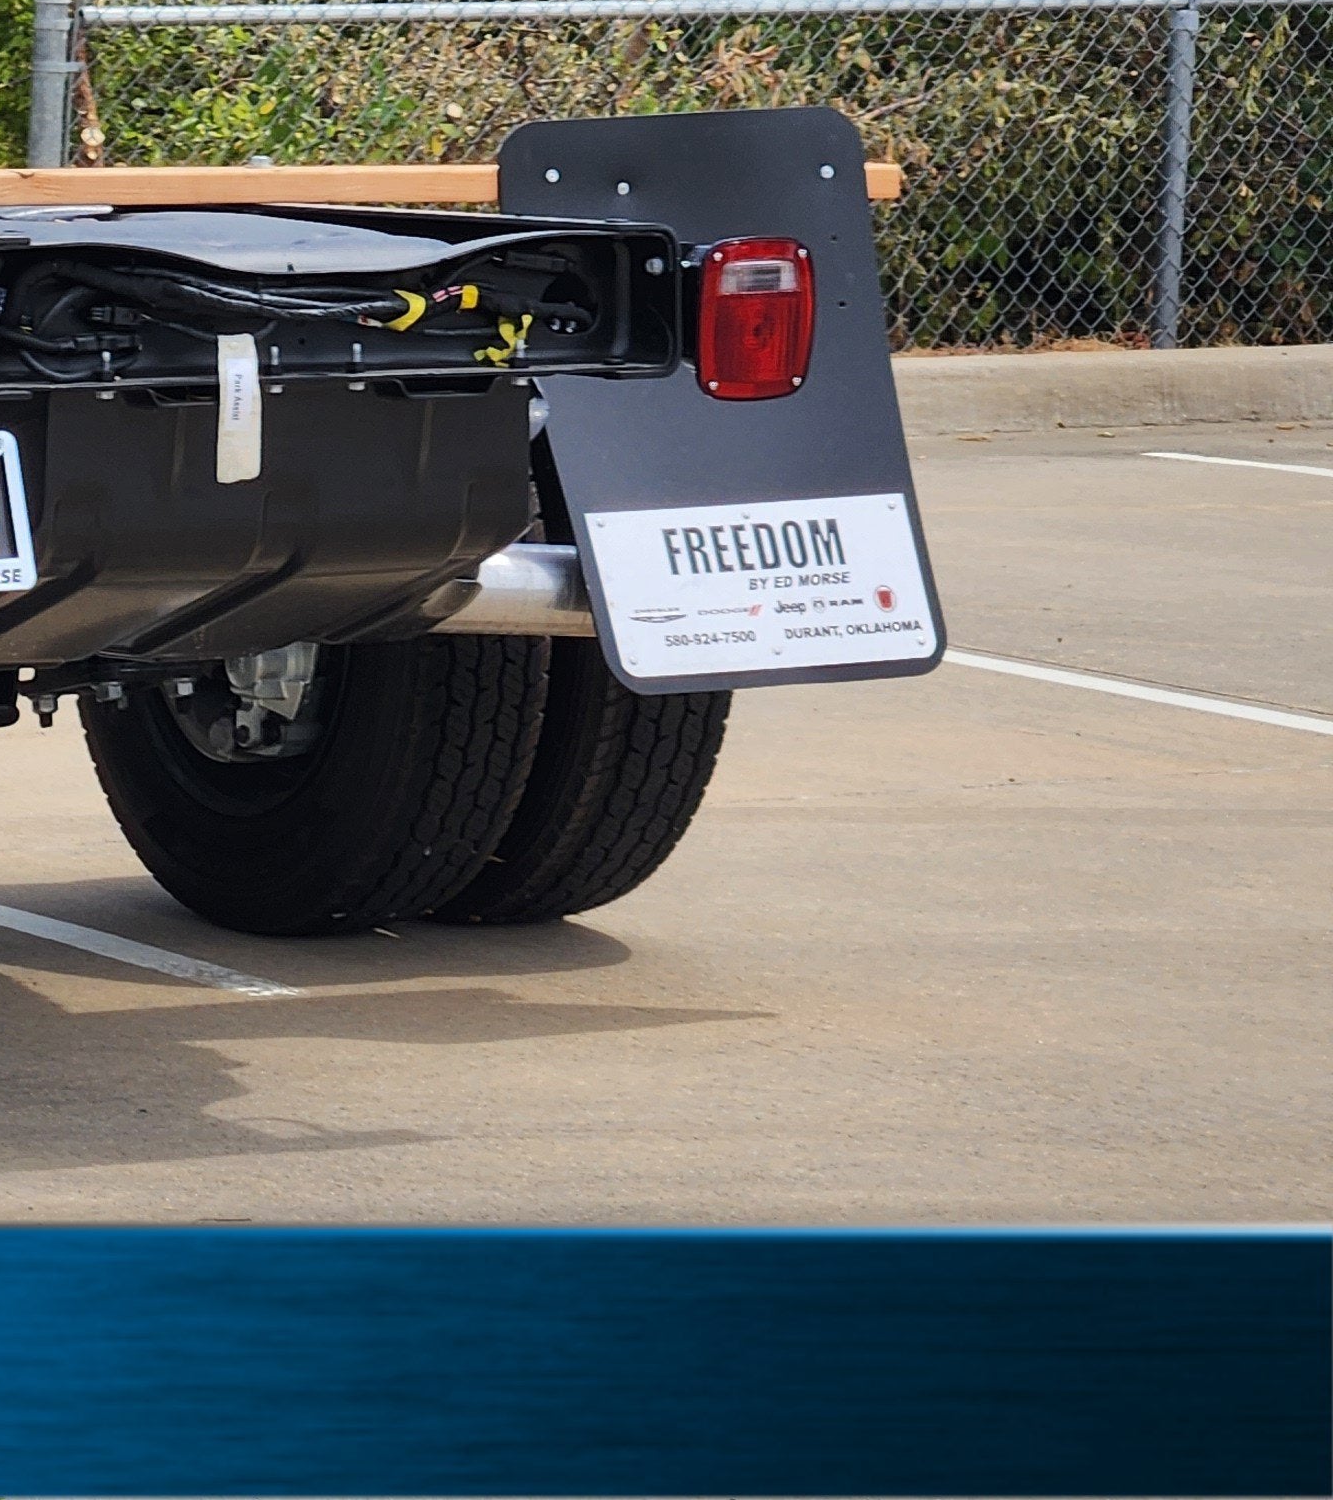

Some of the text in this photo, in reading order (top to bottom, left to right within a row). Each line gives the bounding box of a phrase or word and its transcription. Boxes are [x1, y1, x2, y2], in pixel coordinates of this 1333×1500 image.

[234, 373, 243, 392] Park
[661, 518, 847, 575] FREEDOM
[749, 571, 852, 590] BY ED MORSE
[774, 600, 807, 615] Jeep
[665, 620, 923, 647] 580-924-7500 DURANT, OKLAHOMA
